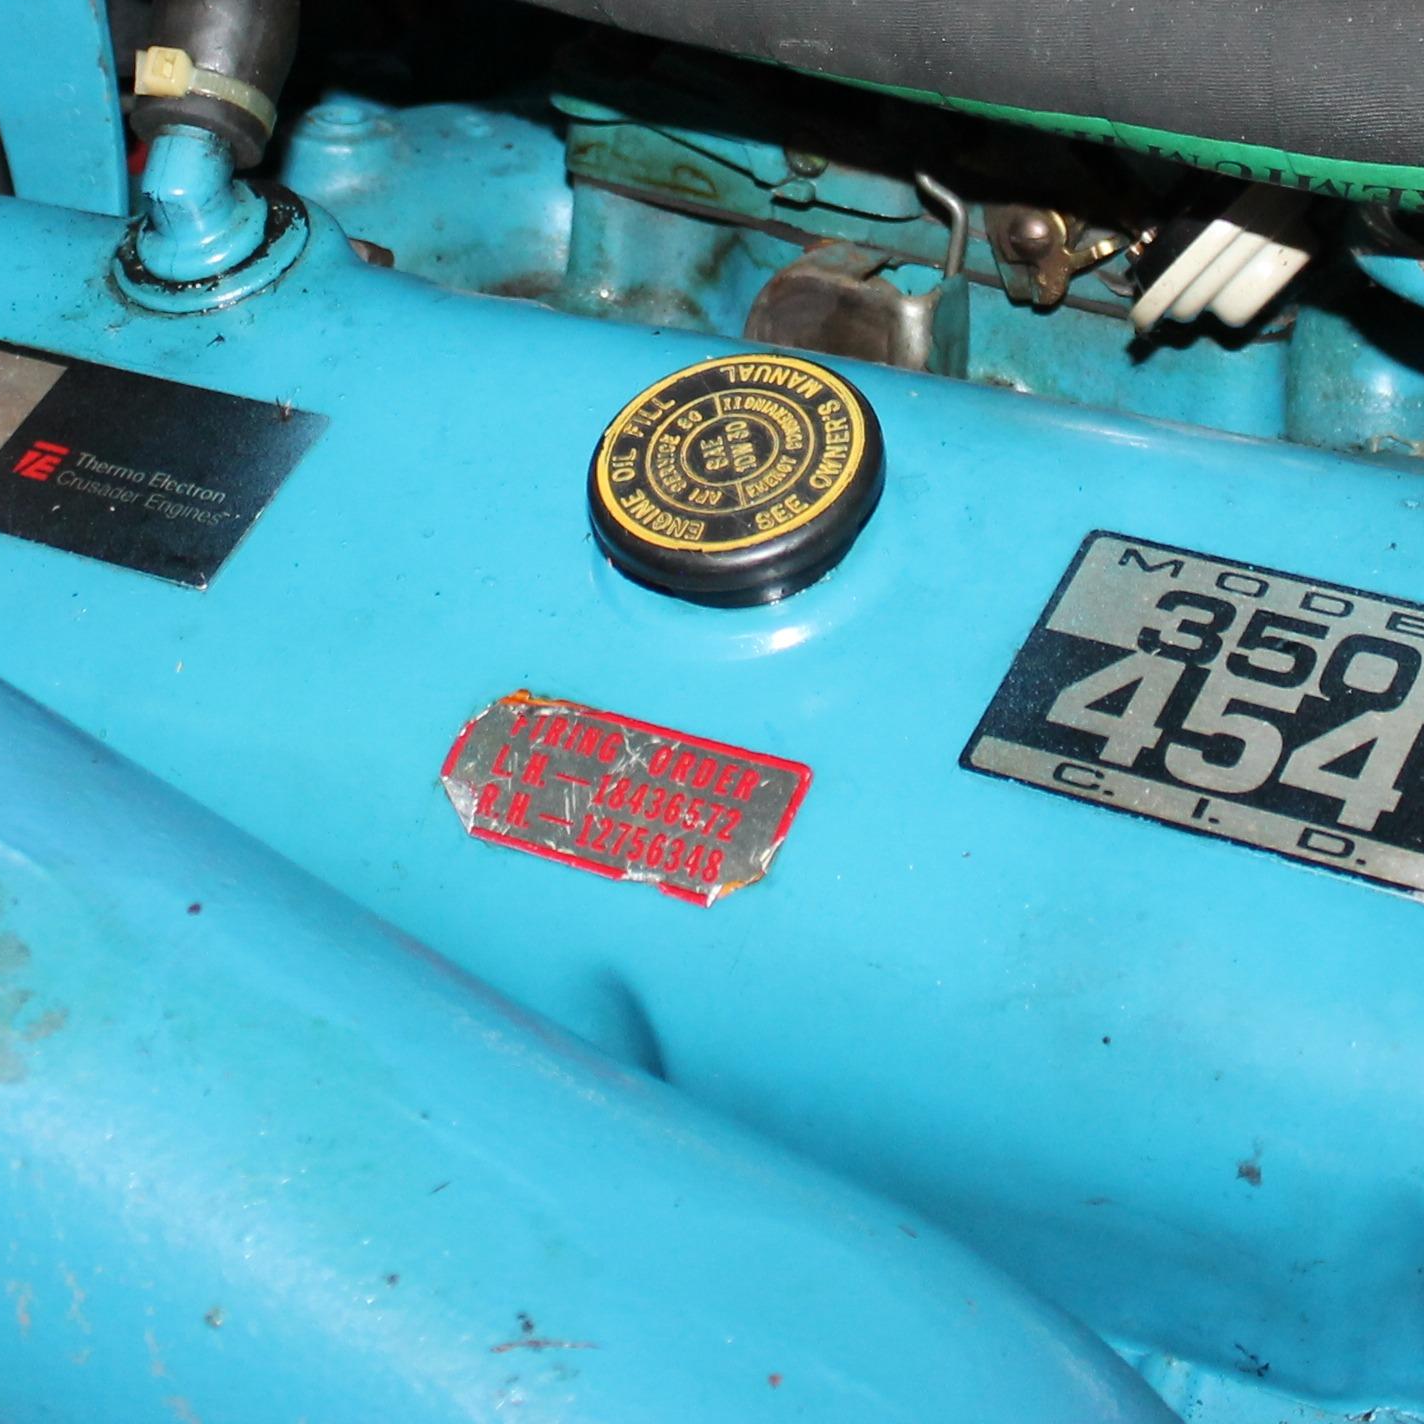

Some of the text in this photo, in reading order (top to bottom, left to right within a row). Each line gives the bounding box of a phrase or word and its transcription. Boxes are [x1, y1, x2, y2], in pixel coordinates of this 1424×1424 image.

[76, 451, 226, 505] Thermo Electron
[611, 396, 706, 542] ENGINE OIL FILL
[700, 435, 729, 472] SAE
[719, 363, 850, 531] SEE OWNER'S MANUAL
[56, 469, 223, 526] Crusader Engines
[1136, 589, 1424, 713] 350
[509, 714, 762, 802] FIRING ORDER
